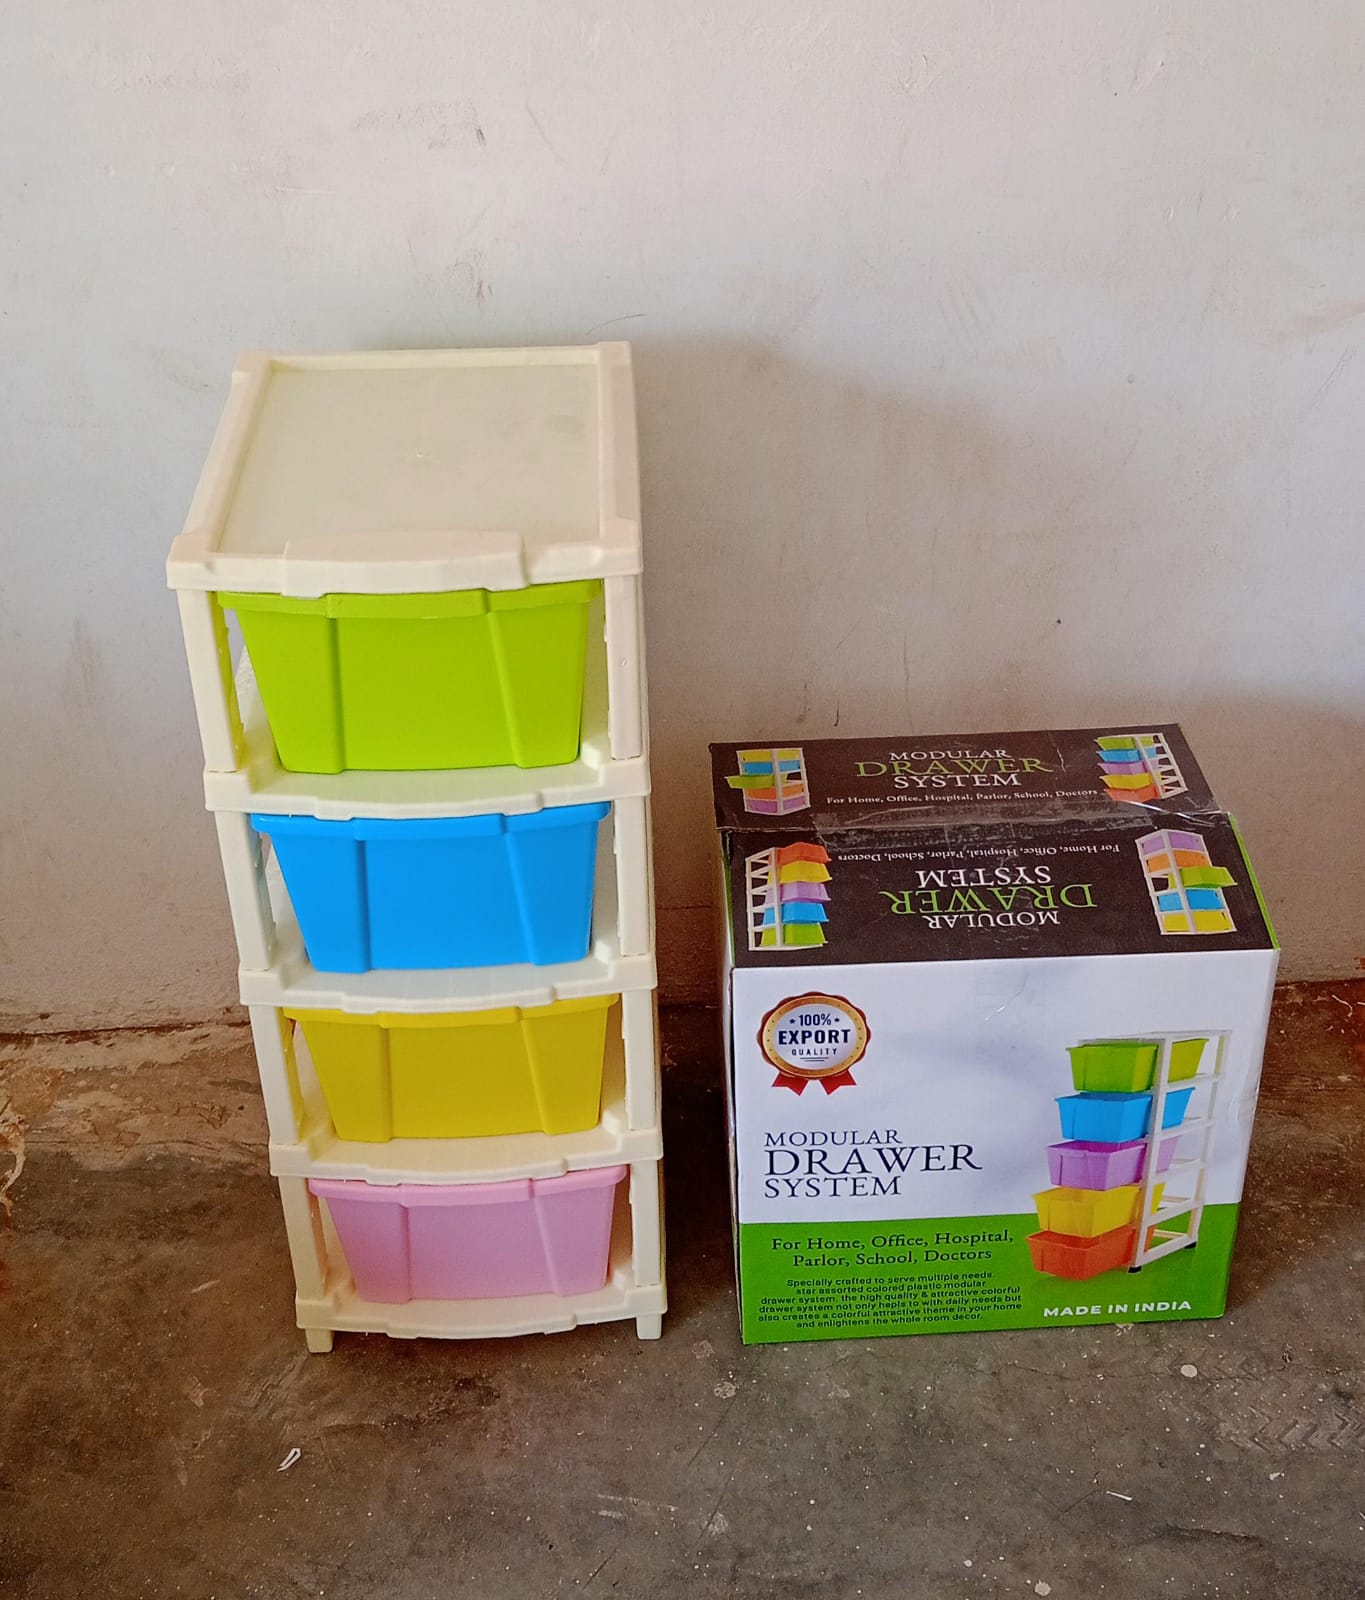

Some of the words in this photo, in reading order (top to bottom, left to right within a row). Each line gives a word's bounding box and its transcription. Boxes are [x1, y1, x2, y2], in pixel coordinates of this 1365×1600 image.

[890, 750, 1012, 760] MODULAR
[854, 758, 1054, 776] DRAWER
[894, 774, 1022, 788] SYSTEM
[925, 793, 973, 802] Hospital,
[976, 792, 1012, 800] Parlor,
[1014, 791, 1053, 799] School,
[1056, 789, 1098, 797] Doctors
[927, 850, 964, 860] Parlor,
[966, 848, 1017, 858] Hospital,
[1020, 847, 1057, 856] Office,
[1060, 846, 1098, 854] Home,
[1100, 844, 1120, 852] For
[838, 853, 881, 862] Doctors
[884, 852, 924, 861] School,
[914, 866, 1052, 888] SYSTEM
[878, 884, 1098, 914] DRAWER
[922, 910, 1060, 929] MODULAR
[799, 1013, 832, 1026] 100%
[778, 1028, 851, 1045] EXPORT
[792, 1048, 838, 1056] QUALITY
[764, 1129, 902, 1146] MODULAR
[765, 1144, 983, 1176] DRAWER
[764, 1176, 902, 1198] SYSTEM
[772, 1238, 802, 1250] For
[807, 1237, 866, 1250] Home,
[871, 1234, 928, 1248] Office,
[935, 1229, 1014, 1246] Hospital,
[793, 1254, 850, 1267] Parlor,
[856, 1250, 918, 1265] School,
[925, 1250, 992, 1262] Doctors
[786, 1278, 832, 1288] Specially
[836, 1277, 872, 1285] crafted
[918, 1273, 959, 1282] multiple
[818, 1286, 864, 1294] assorted
[866, 1284, 904, 1292] colored
[907, 1282, 942, 1292] plastic
[944, 1280, 986, 1289] modular
[860, 1294, 882, 1302] high
[884, 1292, 918, 1301] quality
[930, 1289, 978, 1298] attractive
[981, 1286, 1020, 1295] colorful
[782, 1313, 820, 1321] creates
[831, 1310, 870, 1319] colorful
[873, 1308, 920, 1318] attractive
[923, 1307, 955, 1315] theme
[968, 1304, 992, 1313] your
[994, 1303, 1022, 1311] home
[797, 1304, 833, 1312] system
[855, 1302, 876, 1310] only
[922, 1298, 943, 1306] with
[1043, 1305, 1102, 1318] MADE
[1108, 1304, 1128, 1314] IN
[1134, 1300, 1192, 1312] INDIA
[796, 1320, 815, 1328] and
[818, 1318, 870, 1328] enlightens
[891, 1316, 920, 1324] whole
